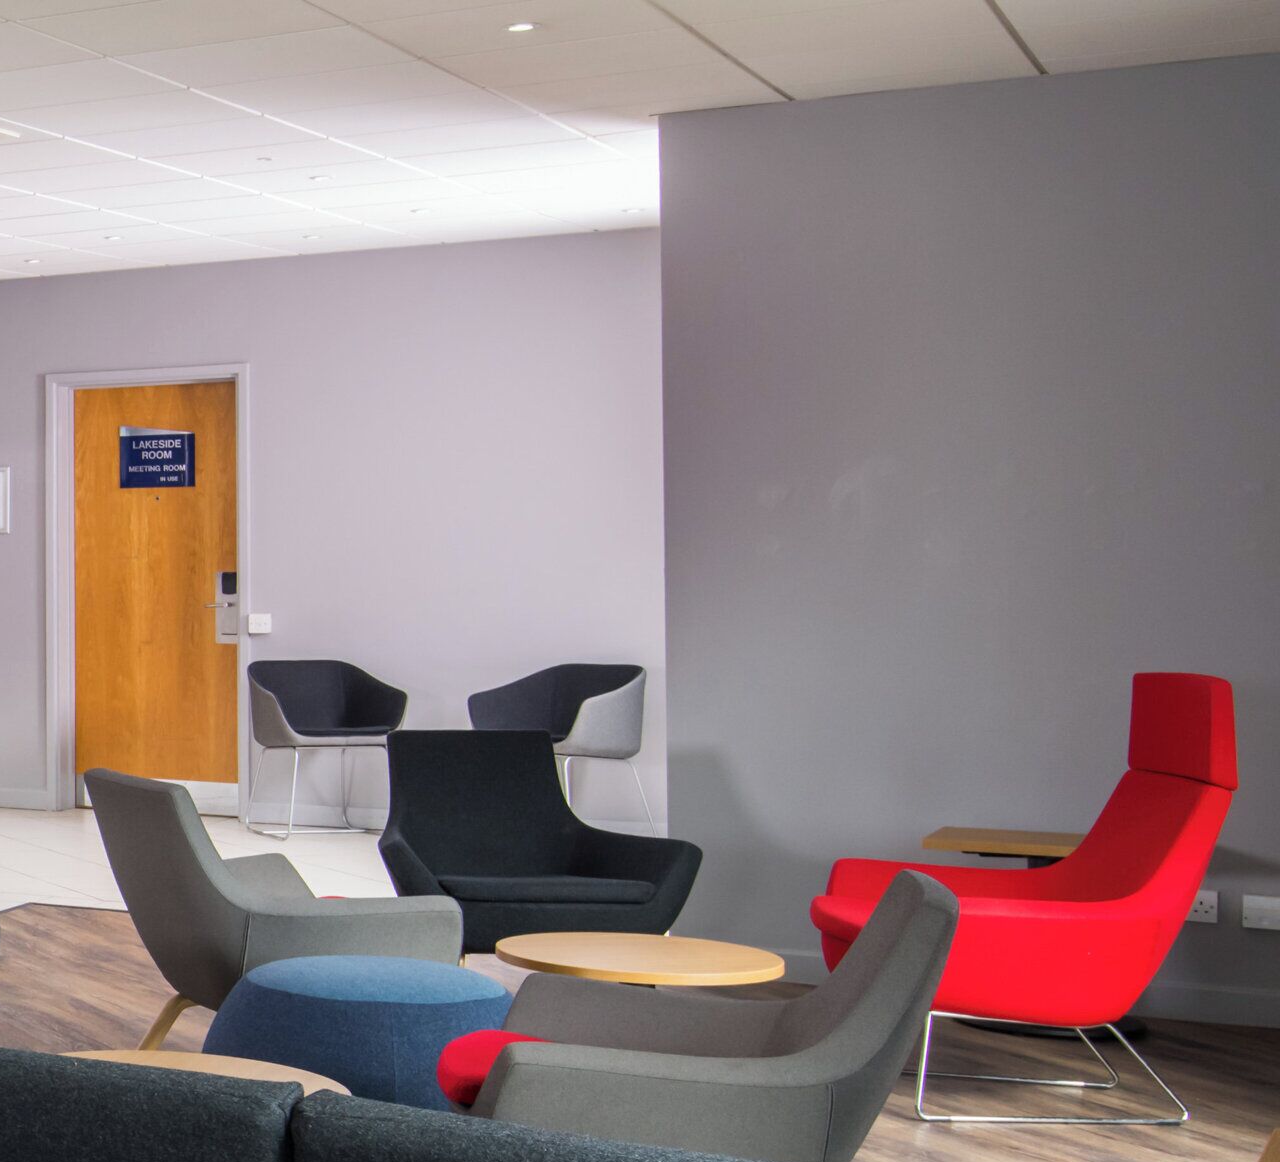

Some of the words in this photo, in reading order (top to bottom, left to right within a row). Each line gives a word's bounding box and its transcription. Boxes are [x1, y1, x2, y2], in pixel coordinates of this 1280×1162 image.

[132, 439, 182, 449] LAKESIDE
[142, 450, 172, 460] ROOM
[128, 465, 161, 473] MEETING
[163, 464, 186, 472] ROOM
